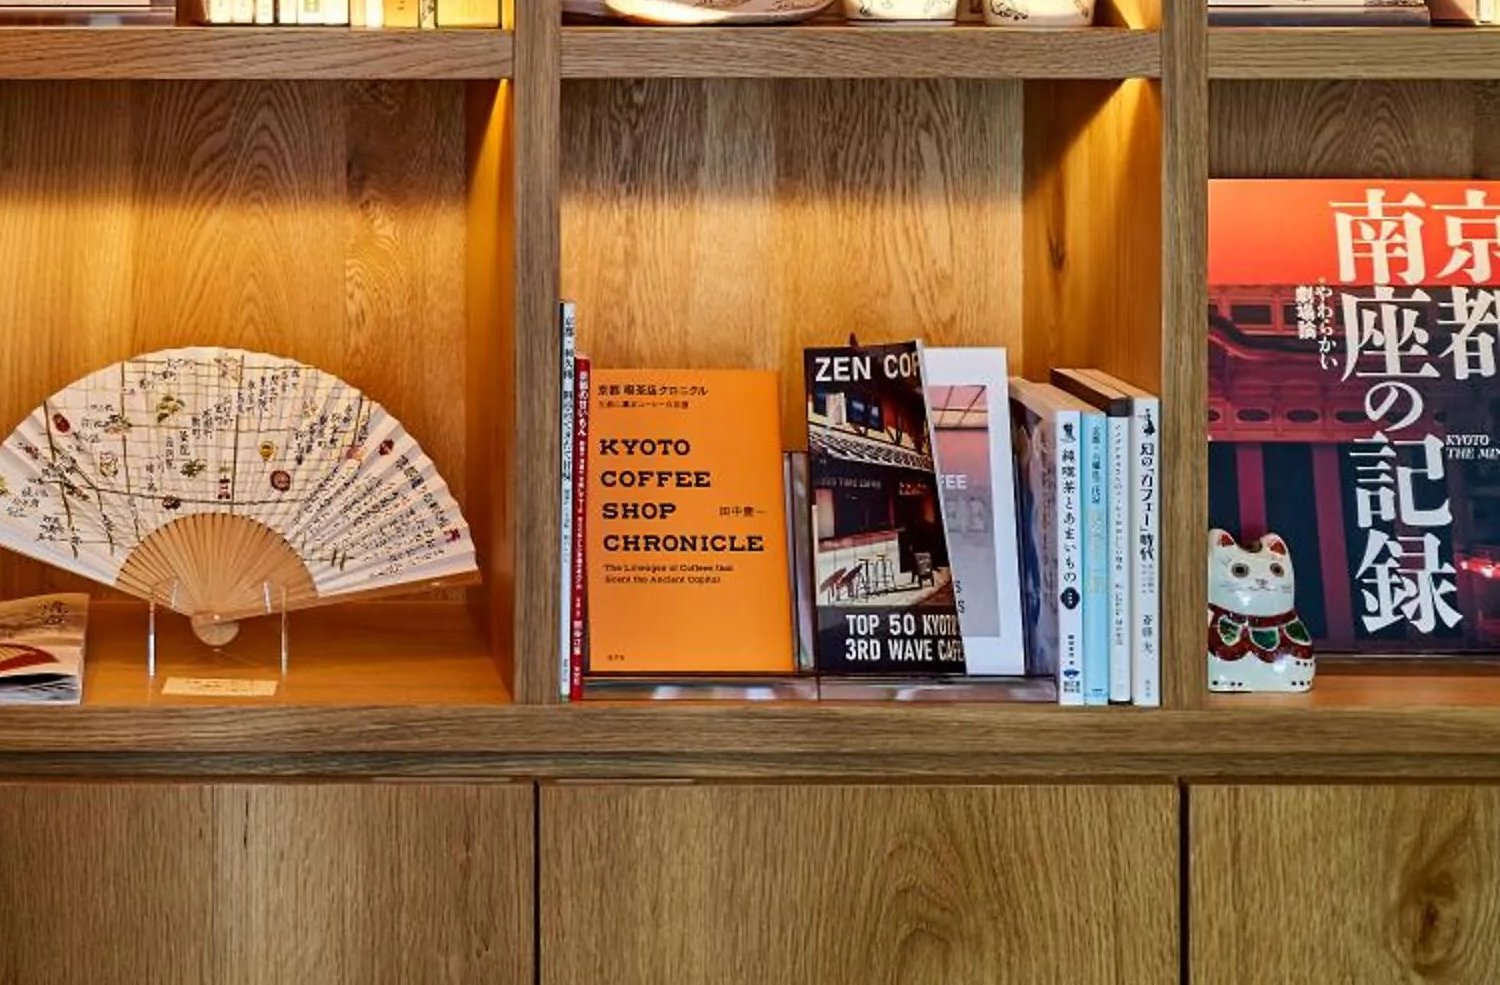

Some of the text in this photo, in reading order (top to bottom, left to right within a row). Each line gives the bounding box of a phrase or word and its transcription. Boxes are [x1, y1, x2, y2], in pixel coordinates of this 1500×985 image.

[1315, 285, 1339, 371] やわらかい
[814, 356, 872, 382] ZEN
[1329, 188, 1463, 636] 南座の記録
[599, 438, 691, 456] KYOTO
[1446, 434, 1490, 446] KYOTO
[1447, 448, 1476, 459] THE
[600, 470, 712, 488] COFFEE
[602, 502, 677, 519] SHOP
[603, 534, 765, 552] CHRONICLE
[845, 614, 879, 636] TOP
[889, 613, 916, 636] 50
[845, 638, 881, 661] 3RD
[887, 638, 933, 661] WAVE
